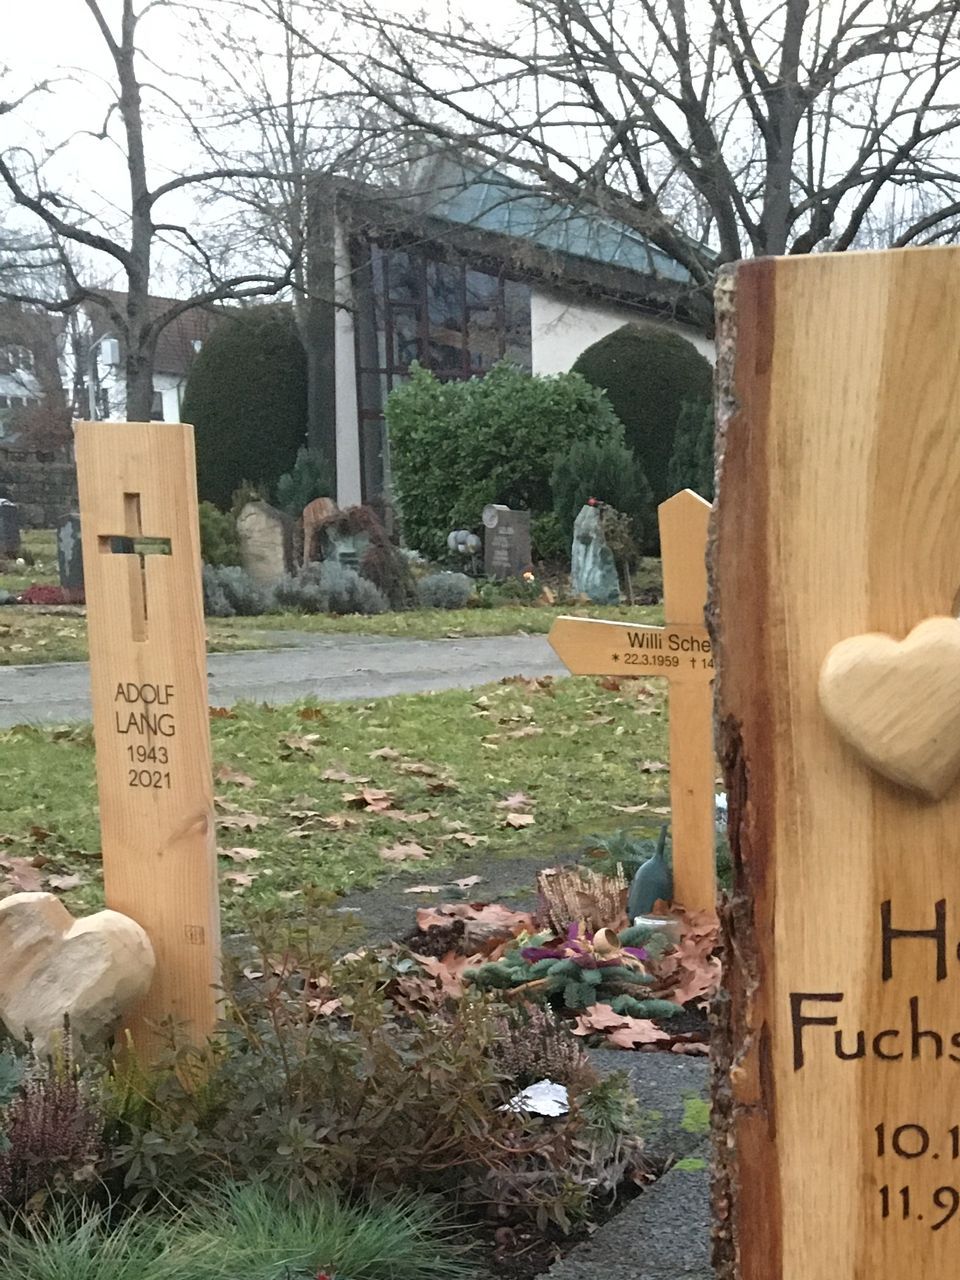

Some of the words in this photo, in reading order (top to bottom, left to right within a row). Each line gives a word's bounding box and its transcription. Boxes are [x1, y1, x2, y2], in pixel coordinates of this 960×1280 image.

[627, 632, 663, 650] Willi
[624, 653, 680, 667] 22.3.1959
[114, 682, 175, 705] ADOLF
[115, 711, 176, 737] LANG
[127, 745, 169, 764] 1943
[128, 769, 171, 789] 2021
